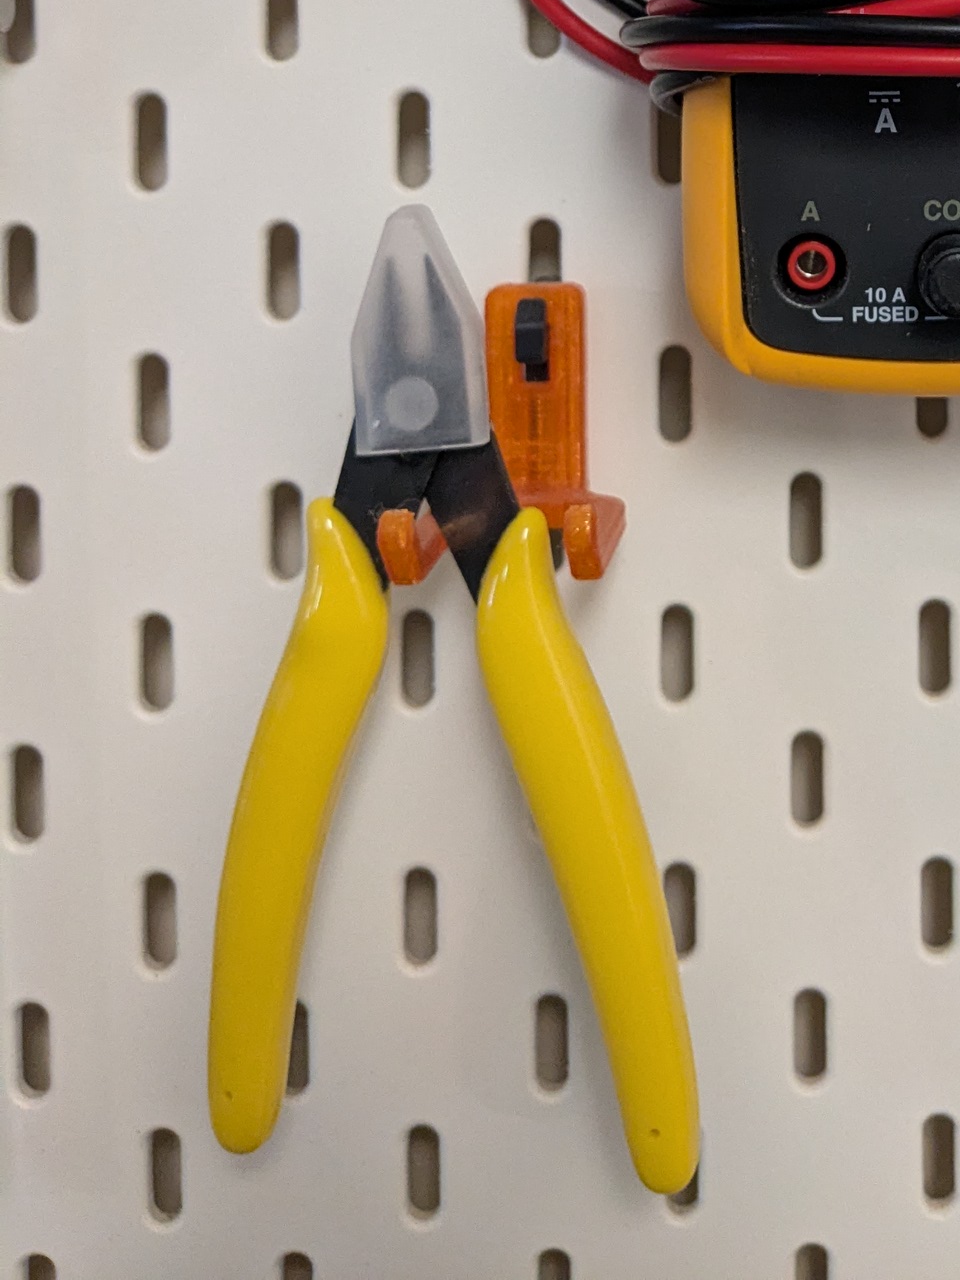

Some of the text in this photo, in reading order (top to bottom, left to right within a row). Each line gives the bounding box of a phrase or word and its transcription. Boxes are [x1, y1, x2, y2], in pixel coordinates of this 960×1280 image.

[874, 107, 898, 134] A
[800, 201, 821, 222] A
[864, 287, 906, 303] 10 A
[852, 305, 919, 323] FUSED
